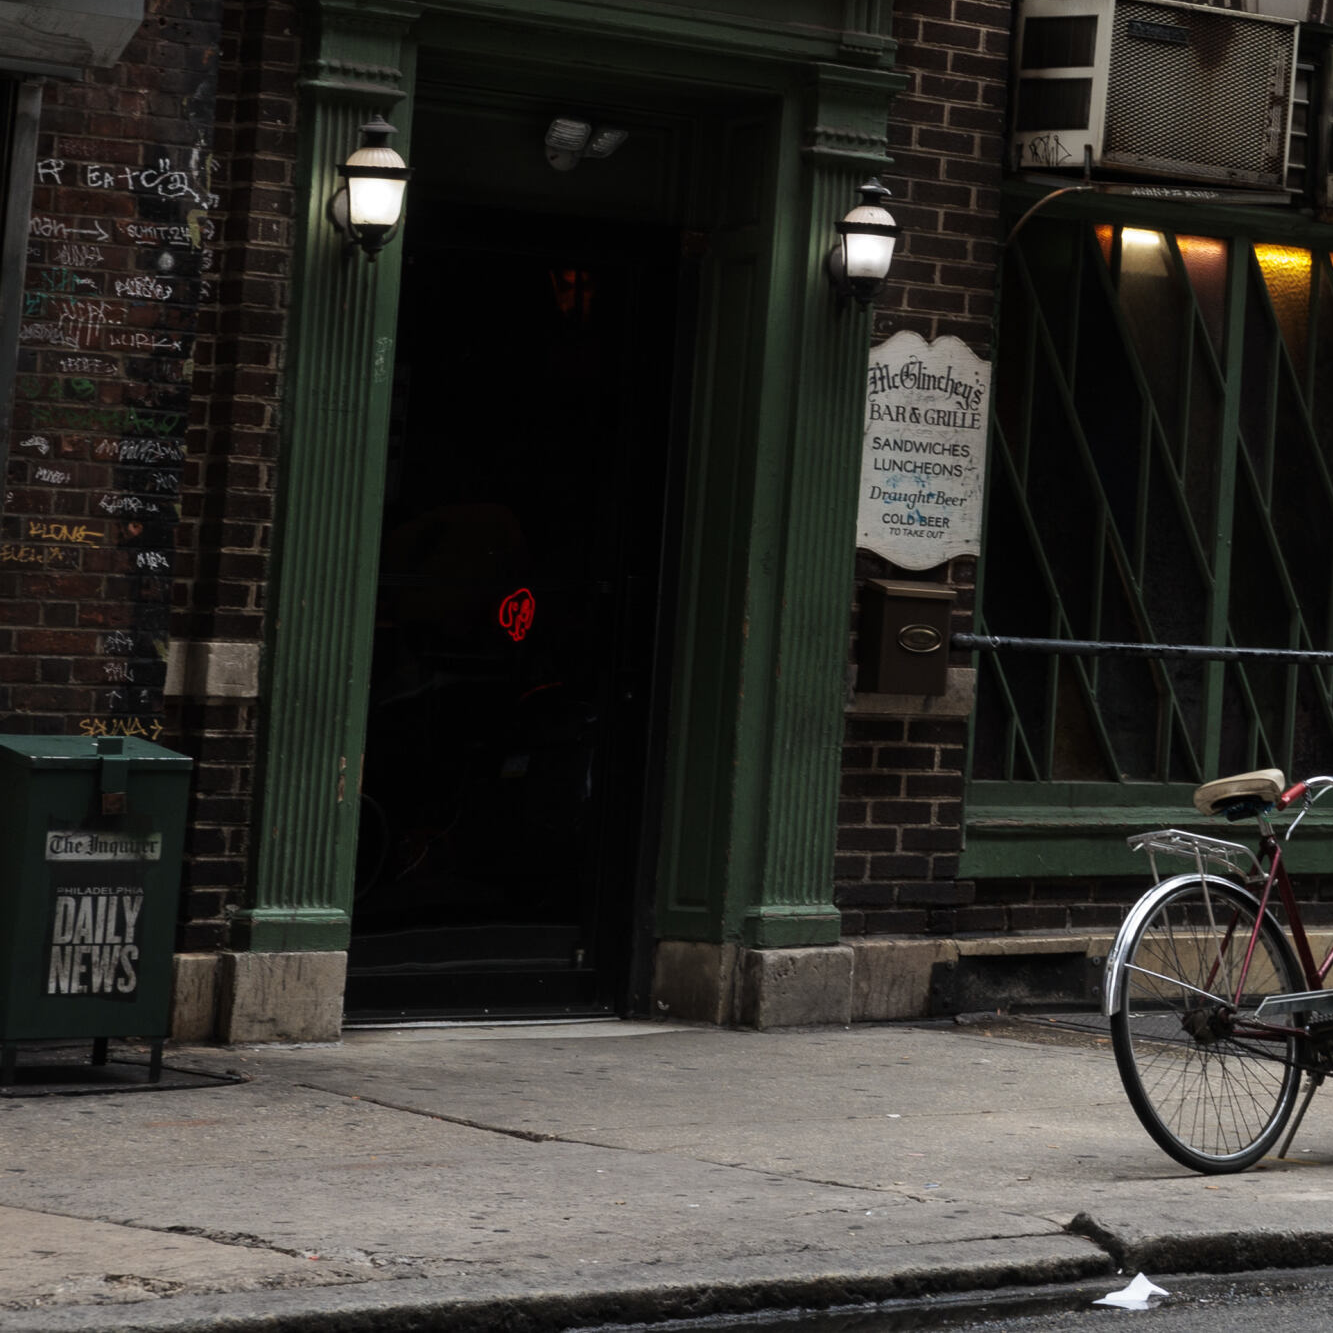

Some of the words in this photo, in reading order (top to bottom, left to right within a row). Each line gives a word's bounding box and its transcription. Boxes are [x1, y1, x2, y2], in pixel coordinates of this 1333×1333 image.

[867, 355, 985, 412] McGlinchey's
[869, 403, 907, 423] BAR
[909, 407, 921, 424] &
[924, 409, 981, 430] GRILLE
[872, 436, 970, 458] SANDWICHES
[874, 458, 963, 477] LUNCHEONS
[869, 485, 931, 510] Draught
[935, 490, 967, 507] Beer
[881, 513, 915, 526] COLD
[919, 515, 950, 529] BEER
[889, 527, 901, 536] TO
[903, 528, 925, 538] TAKE
[926, 529, 945, 539] OUT
[49, 834, 83, 855] The
[85, 833, 159, 857] Inquier
[56, 886, 144, 896] PHILADELPHIA
[52, 895, 145, 945] DAILY
[47, 944, 140, 995] NEWS
